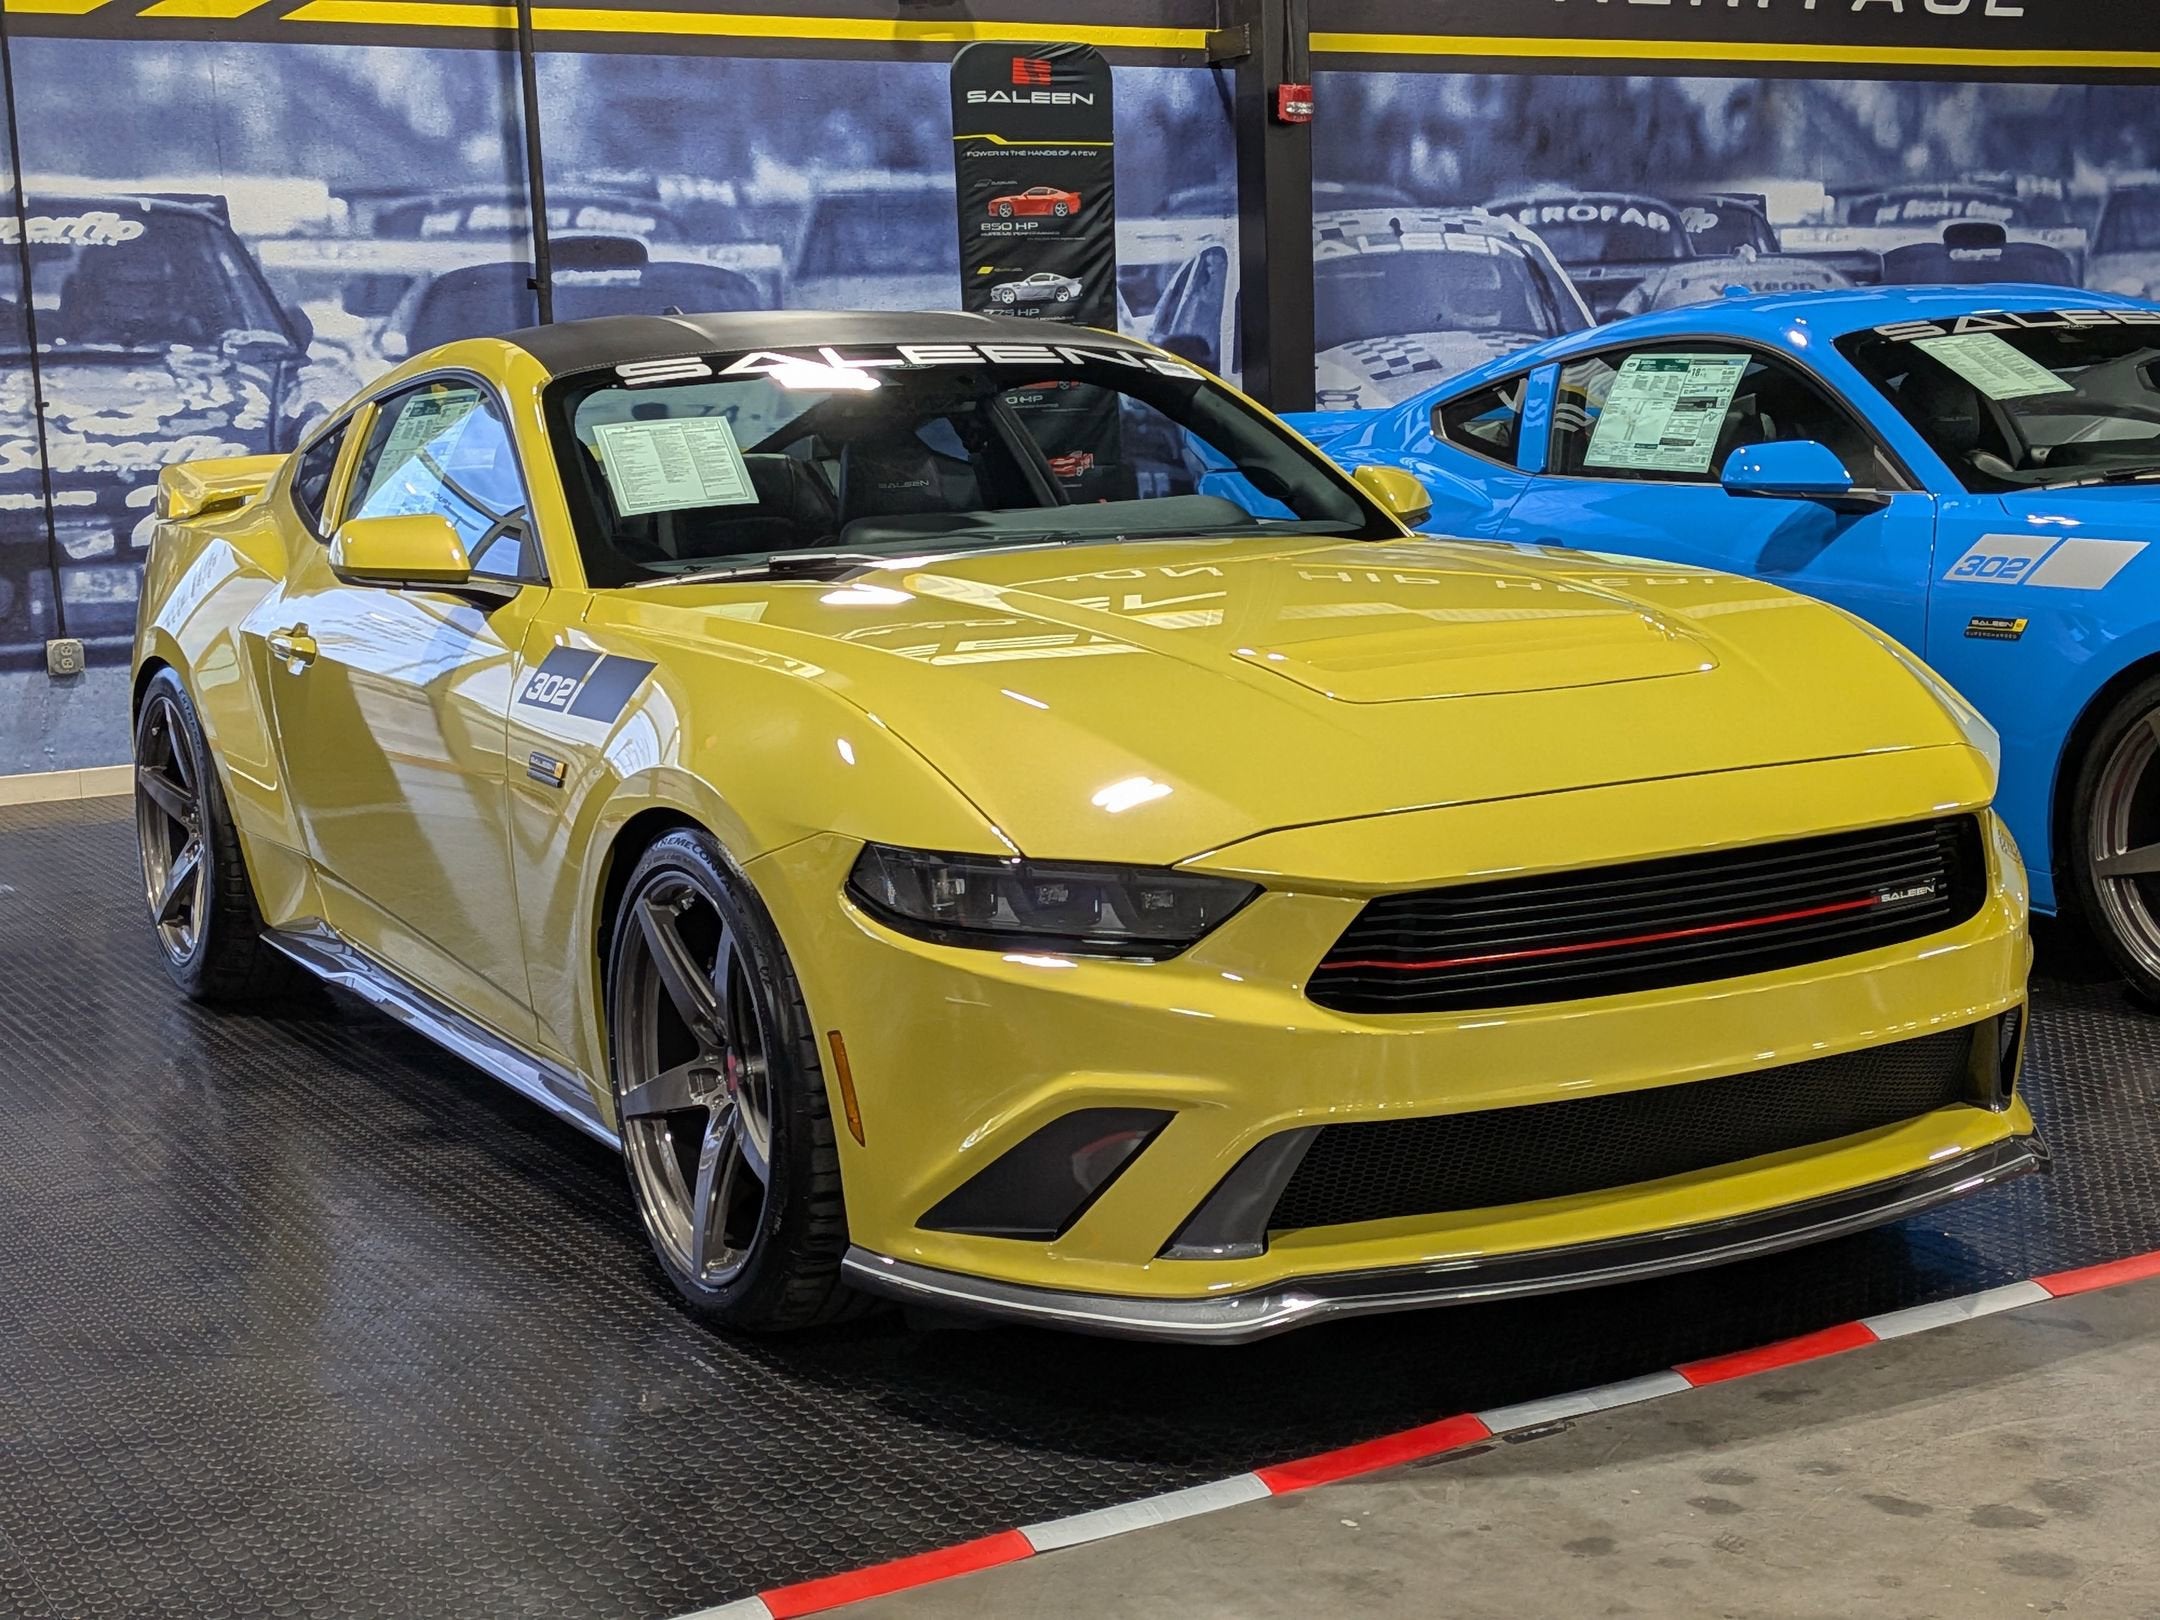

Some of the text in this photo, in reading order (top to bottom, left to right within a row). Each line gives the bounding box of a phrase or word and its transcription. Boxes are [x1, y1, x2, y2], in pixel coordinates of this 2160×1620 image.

[967, 90, 1094, 105] SALEEN
[967, 150, 999, 158] POWER
[981, 222, 1038, 231] 850 HP
[1018, 308, 1040, 317] HP
[1873, 309, 2160, 342] SALEE
[615, 345, 1148, 385] SALEEN
[1954, 555, 2031, 579] 302
[1972, 619, 2014, 628] SALEEN
[526, 672, 577, 706] 302
[1881, 885, 1935, 902] SALEEN
